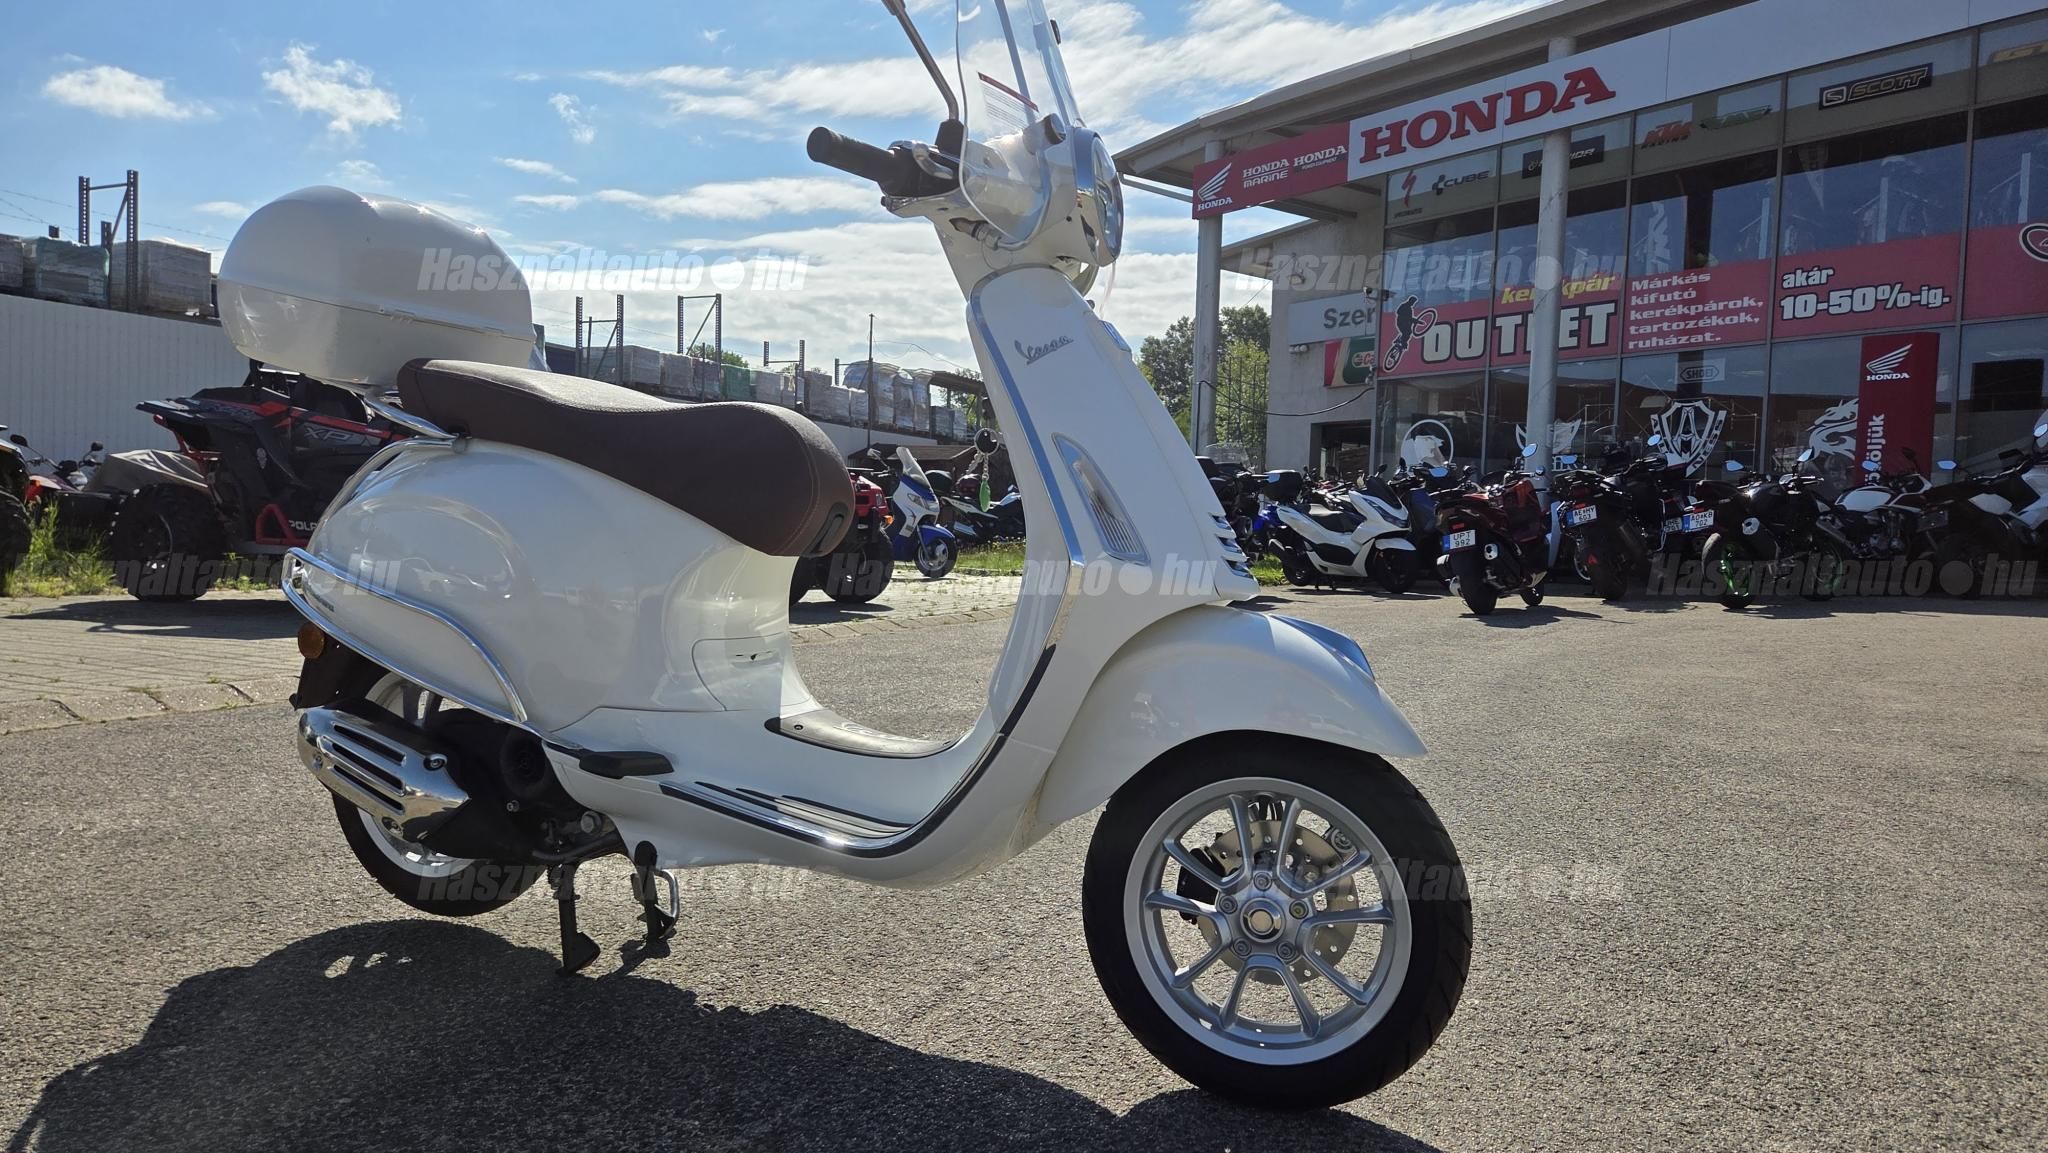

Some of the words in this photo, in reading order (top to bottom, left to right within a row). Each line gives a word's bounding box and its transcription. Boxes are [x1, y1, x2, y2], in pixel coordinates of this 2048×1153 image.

[1849, 68, 1926, 100] SCOTT
[1360, 66, 1616, 163] HONDA
[1293, 145, 1347, 167] HONDA
[1243, 158, 1289, 178] HONDA
[1243, 169, 1288, 189] MARINE
[1444, 170, 1490, 188] CUBE
[1198, 197, 1232, 211] HONDA
[1501, 273, 1615, 304] kerkpár
[1632, 272, 1711, 291] Márkás
[1782, 267, 1834, 289] akár
[1631, 288, 1697, 306] kifutó
[1780, 283, 1950, 320] 10-50%-ig.
[1630, 296, 1763, 320] kerékpárok,
[1629, 312, 1760, 335] tartozékok,
[1628, 332, 1721, 349] ruházat.
[1866, 372, 1911, 381] HONDA
